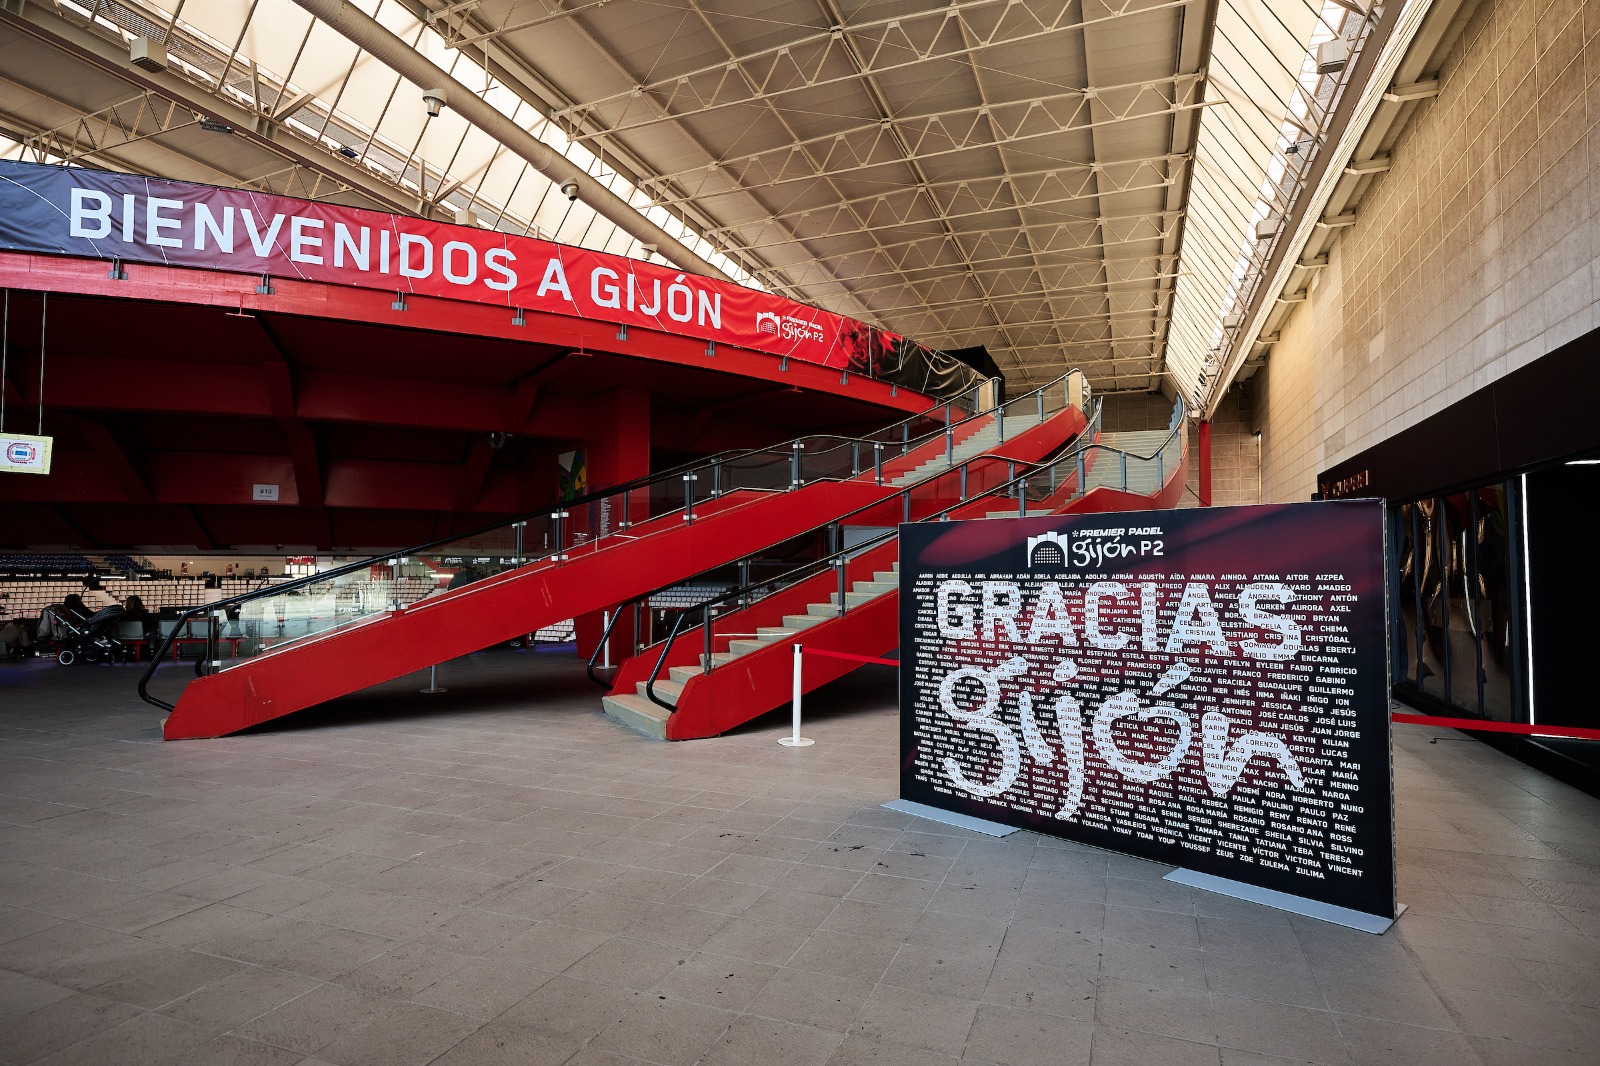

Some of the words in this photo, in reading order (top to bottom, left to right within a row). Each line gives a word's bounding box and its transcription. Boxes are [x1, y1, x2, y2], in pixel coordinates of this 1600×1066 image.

[69, 187, 518, 292] BIENVENIDOS
[535, 258, 574, 300] A
[589, 266, 722, 330] GIJÓN
[782, 322, 812, 342] gijón
[814, 332, 824, 342] P2
[1080, 528, 1125, 537] PREMIER
[1128, 527, 1163, 536] PADEL
[1072, 536, 1136, 568] gijón
[1140, 541, 1163, 556] P2
[1329, 593, 1357, 601] ANTÓN
[937, 579, 1303, 661] GRACIAS
[1283, 643, 1319, 651] DOUGLAS
[1305, 633, 1349, 643] CRISTÓBAL
[1223, 659, 1250, 667] EVELYN
[1255, 661, 1284, 669] EYLEEN
[1319, 666, 1357, 675] FABRICIO
[1301, 655, 1338, 663] ENCARNA
[1124, 670, 1152, 678] GONZALO
[1188, 675, 1211, 683] GORKA
[1217, 678, 1251, 686] GRACIELA
[1257, 681, 1302, 691] GUADALUPE
[1308, 685, 1354, 695] GUILLERMO
[1126, 661, 1160, 669] FRANCISCO
[1232, 669, 1261, 677] FRANCO
[1267, 672, 1309, 681] FREDERICO
[1315, 676, 1346, 684] GABINO
[1166, 691, 1187, 699] JASON
[1192, 694, 1216, 702] JAVIER
[1221, 697, 1255, 706] JENNIFER
[1260, 701, 1292, 710] JESSICA
[1298, 703, 1323, 713] JESÚS
[1330, 706, 1356, 717] JESÚS
[1180, 684, 1207, 692] IGNACIO
[1233, 687, 1250, 696] INÉS
[1280, 691, 1300, 701] IÑAKI
[1307, 694, 1328, 703] IÑIGO
[1154, 699, 1175, 707] JORGE
[1180, 701, 1197, 709] JOSÉ
[1202, 703, 1219, 712] JOSÉ
[1221, 706, 1252, 716] ANTONIO
[1257, 709, 1276, 718] JOSÉ
[1278, 713, 1309, 722] CARLOS
[1314, 715, 1335, 725] JOSÉ
[1337, 719, 1356, 727] LUIS
[938, 656, 1305, 820] gijón
[1258, 720, 1278, 729] JUAN
[1279, 721, 1304, 732] JESÚS
[1310, 726, 1331, 735] JUAN
[1333, 729, 1360, 738] JORGE
[1292, 734, 1316, 743] KEVIN
[1322, 738, 1349, 747] KILIAN
[1245, 738, 1278, 748] LORENZO
[1321, 748, 1347, 758] LUCAS
[1249, 758, 1270, 767] LUISA
[1302, 766, 1325, 775] PILAR
[1332, 769, 1358, 780] MARÍA
[1339, 761, 1360, 770] MARI
[1243, 767, 1259, 775] MAX
[1264, 770, 1290, 780] MAYRA
[1297, 775, 1323, 785] MAYTE
[1330, 780, 1359, 791] MENNO
[1253, 778, 1278, 788] NACHO
[1322, 789, 1350, 800] NAROA
[1177, 785, 1207, 795] PATRICIA
[1232, 794, 1255, 804] PAULA
[1261, 799, 1293, 811] PAULINO
[1299, 806, 1326, 817] PAULO
[1332, 812, 1348, 821] PAZ
[1178, 775, 1202, 785] NOELIA
[1236, 784, 1259, 795] NOEMÍ
[1265, 790, 1286, 800] NORA
[1292, 795, 1334, 808] NORBERTO
[1340, 803, 1364, 813] NUNO
[1178, 792, 1196, 803] RAÚL
[1201, 798, 1228, 809] REBECA
[1233, 804, 1263, 815] REMIGIO
[1269, 811, 1290, 820] REMY
[1296, 816, 1327, 827] RENATO
[1334, 821, 1356, 833] RENÉ
[1186, 805, 1204, 814] ROSA
[1205, 807, 1227, 818] MARÍA
[1233, 814, 1265, 826] ROSARIO
[1270, 821, 1304, 833] ROSARIO
[1306, 828, 1323, 837] ANA
[1329, 832, 1352, 843] ROSS
[1134, 812, 1159, 823] SUSANA
[1194, 825, 1222, 836] TAMARA
[1228, 832, 1249, 842] TANIA
[1255, 837, 1286, 850] TATIANA
[1292, 845, 1313, 856] TEBA
[1319, 851, 1351, 864] TERESA
[1138, 804, 1156, 813] SEILA
[1187, 814, 1211, 825] SERGIO
[1217, 820, 1259, 834] SHEREZADE
[1264, 830, 1292, 841] SHEILA
[1298, 836, 1324, 848] SILVIA
[1330, 843, 1363, 856] SILVINO
[1150, 823, 1183, 837] VERÓNICA
[1187, 833, 1211, 844] VICENT
[1216, 839, 1246, 851] VICENTE
[1252, 845, 1279, 858] VÍCTOR
[1284, 854, 1321, 868] VICTORIA
[1327, 863, 1363, 877] VINCENT
[1215, 848, 1234, 858] ZEUS
[1239, 854, 1253, 862] ZOE
[1259, 858, 1289, 871] ZULEMA
[1295, 866, 1325, 879] ZULIMA
